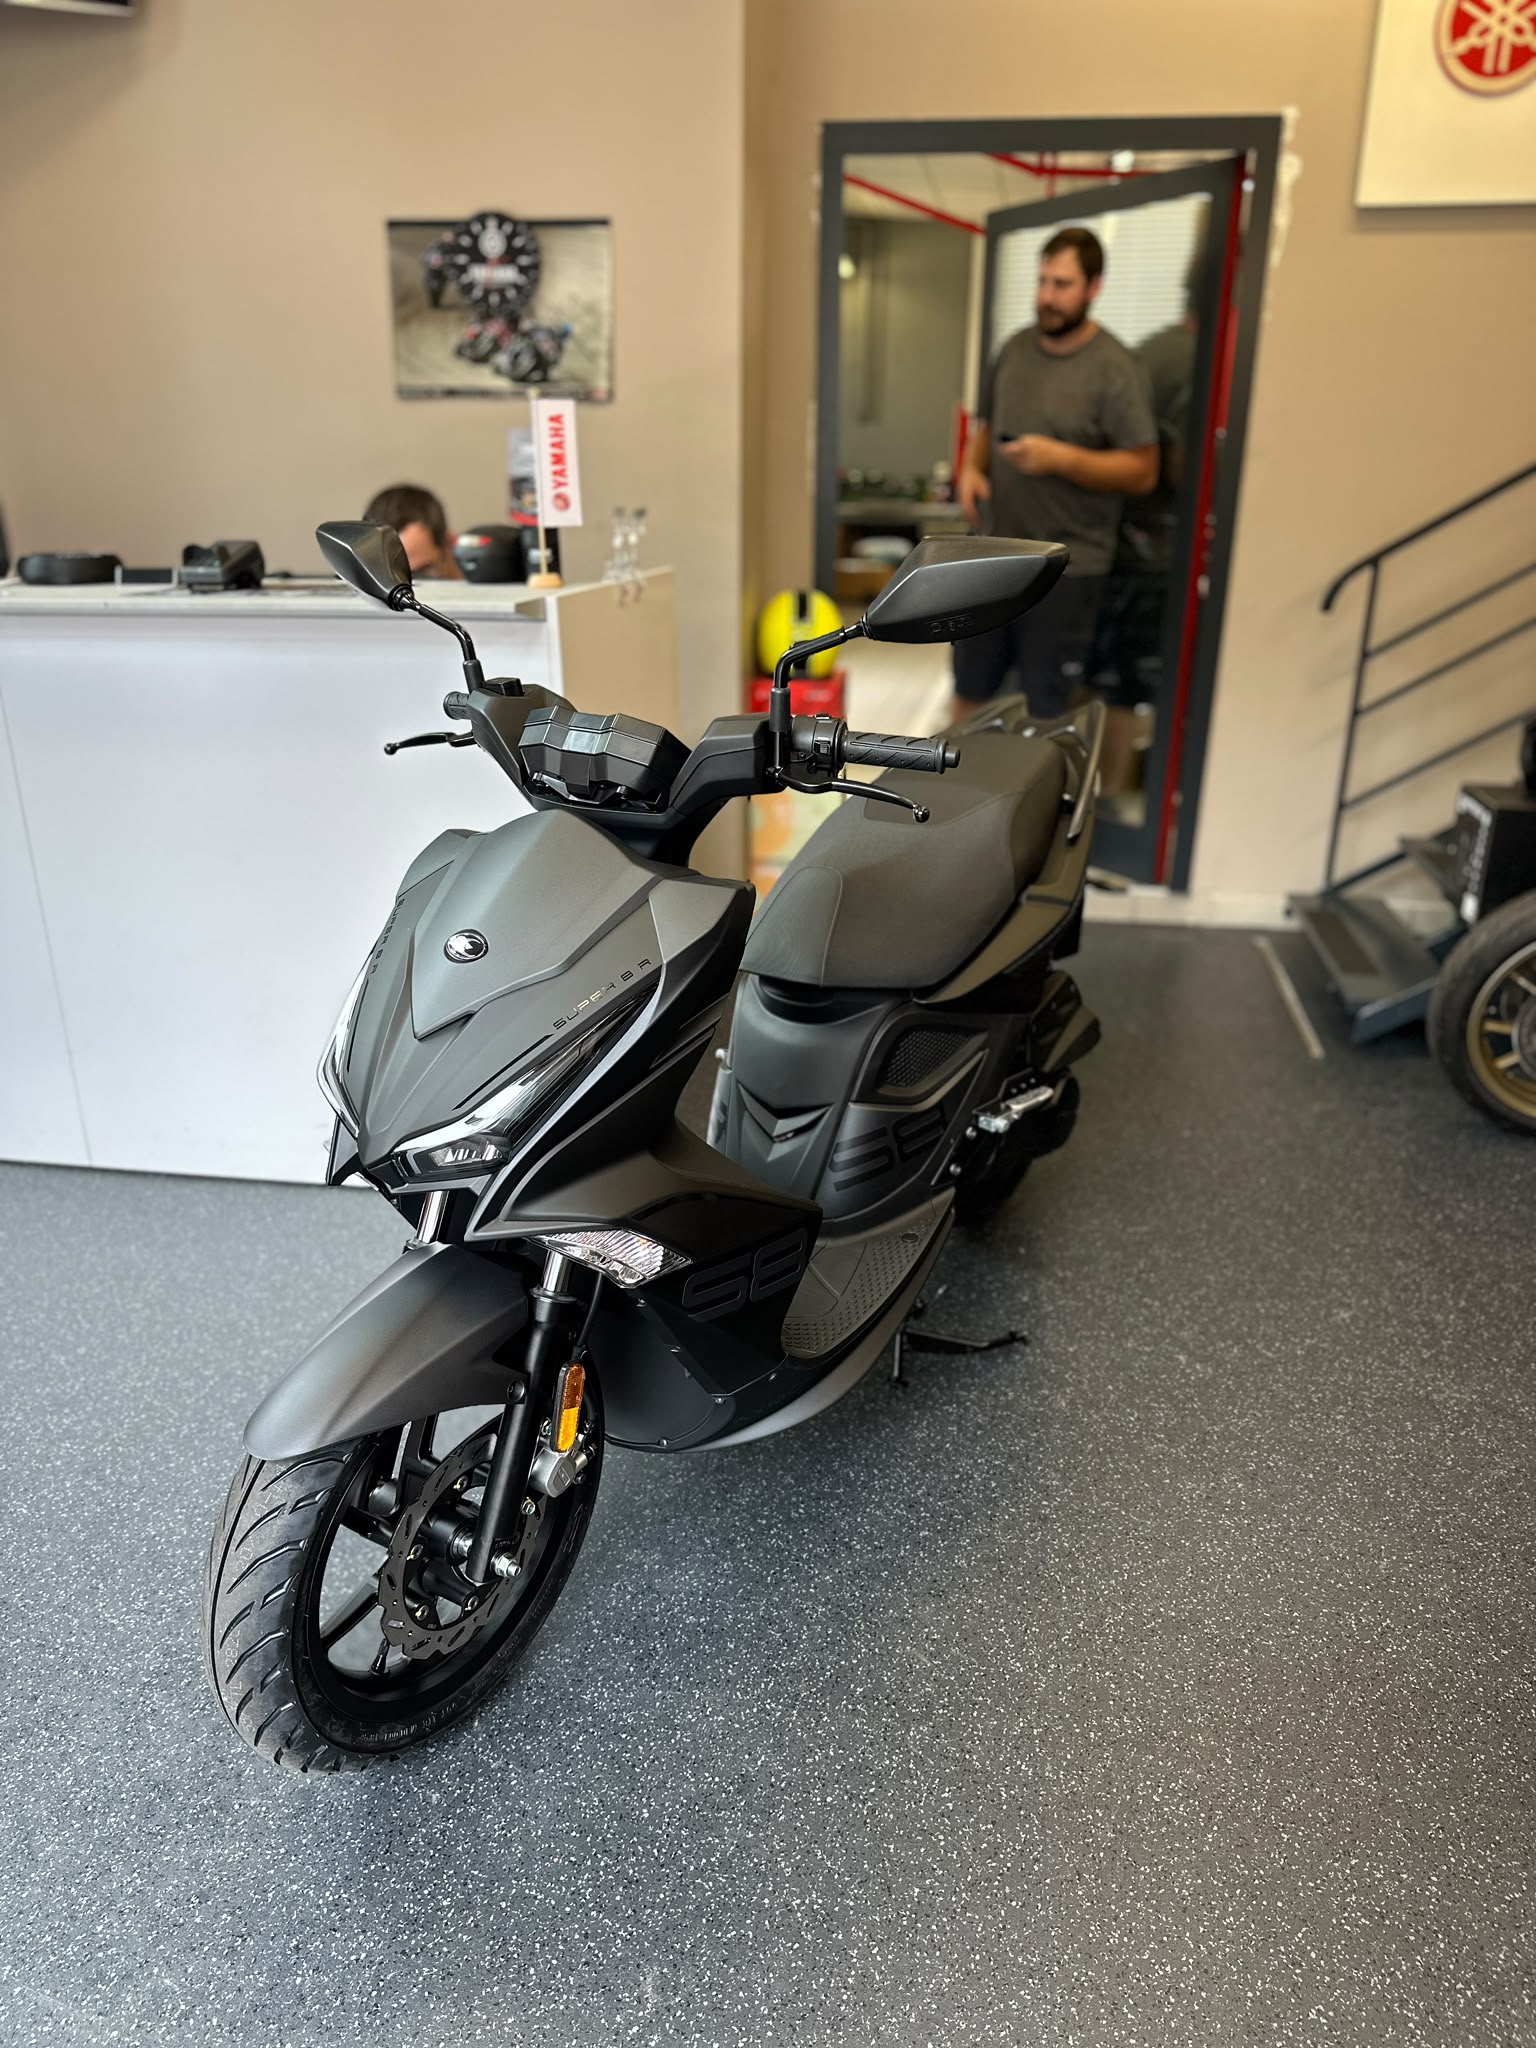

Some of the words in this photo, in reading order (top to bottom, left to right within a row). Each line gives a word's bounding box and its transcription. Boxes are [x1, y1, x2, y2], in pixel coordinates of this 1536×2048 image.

[548, 414, 568, 490] YAMAHA
[381, 898, 406, 945] SUPER
[552, 982, 616, 1030] SUPER
[637, 958, 652, 970] R
[829, 1107, 945, 1191] S8
[681, 1229, 808, 1322] S8
